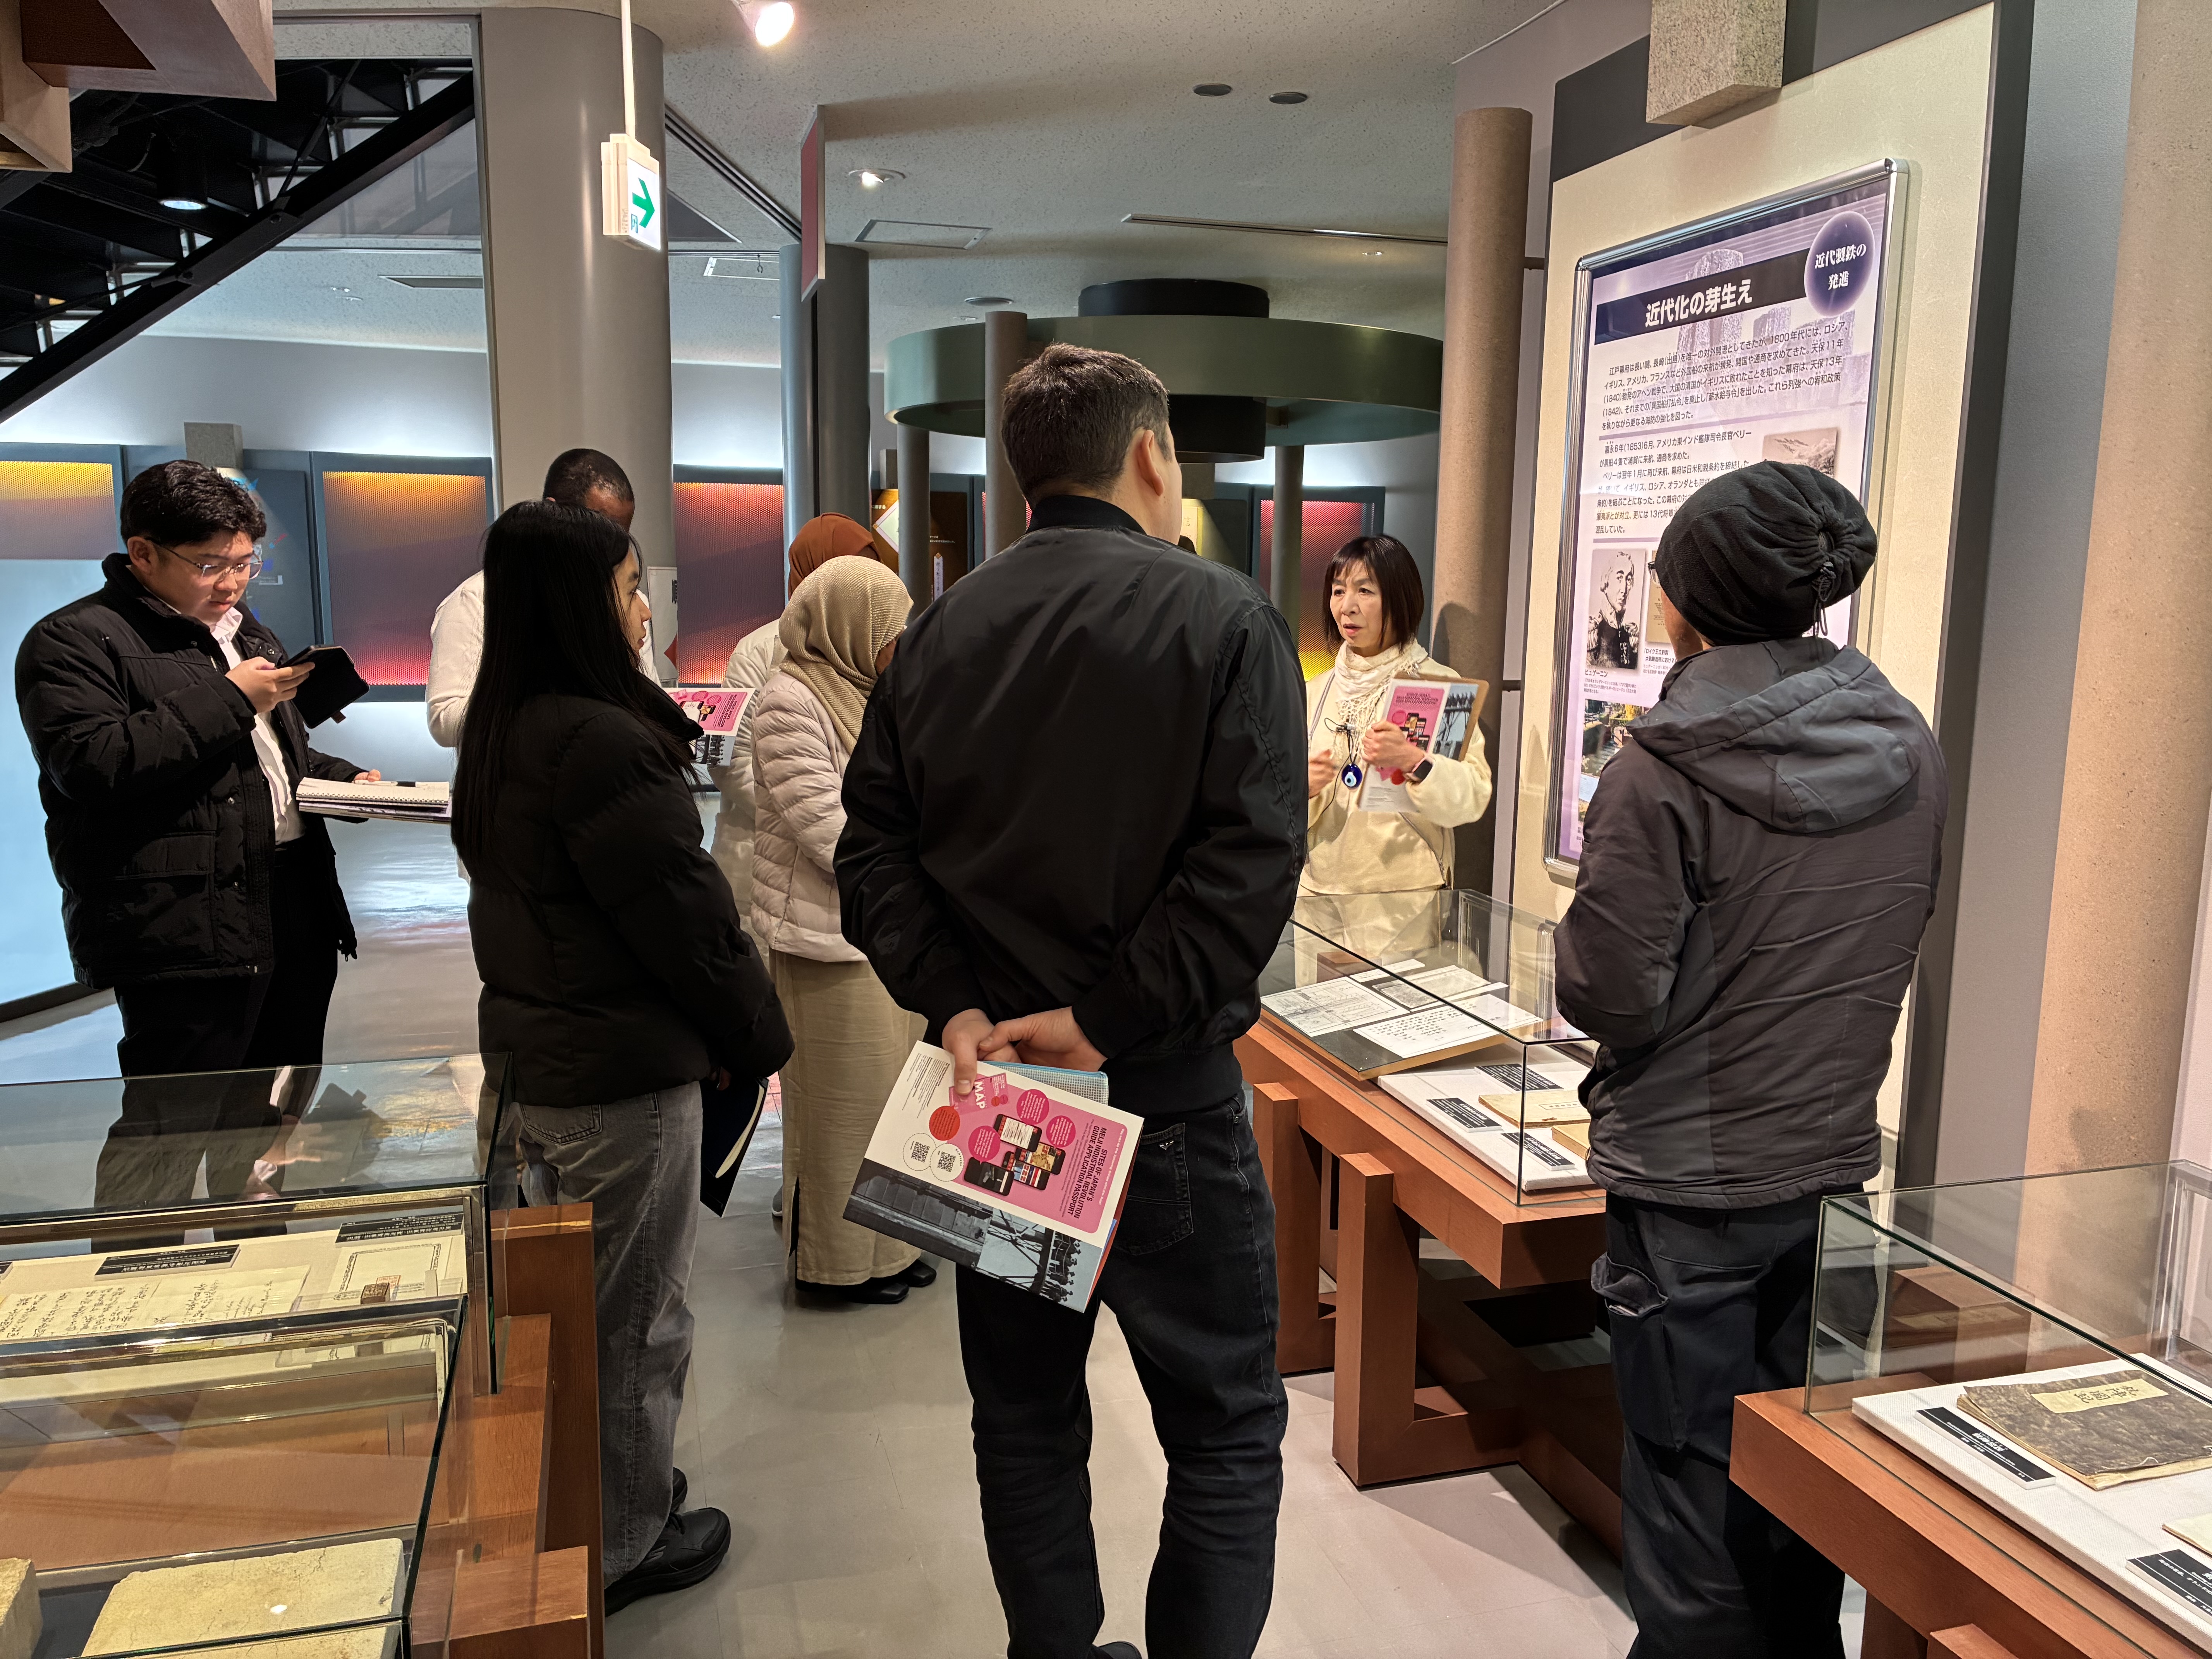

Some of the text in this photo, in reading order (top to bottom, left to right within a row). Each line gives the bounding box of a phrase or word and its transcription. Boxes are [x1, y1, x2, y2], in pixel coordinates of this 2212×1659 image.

[1814, 243, 1867, 269] 近代製鉄の
[1827, 271, 1849, 291] 発進
[1645, 278, 1753, 327] 近代化の芽生え
[974, 1081, 984, 1109] MAP
[1089, 1125, 1099, 1144] GUIDE
[1077, 1144, 1093, 1183] APPLICATION
[1094, 1166, 1102, 1175] OF
[1097, 1149, 1108, 1166] SITES
[1073, 1127, 1106, 1218] MEIJI INDUSTRIAL REVOLUTION
[1066, 1184, 1081, 1215] PASSPORT
